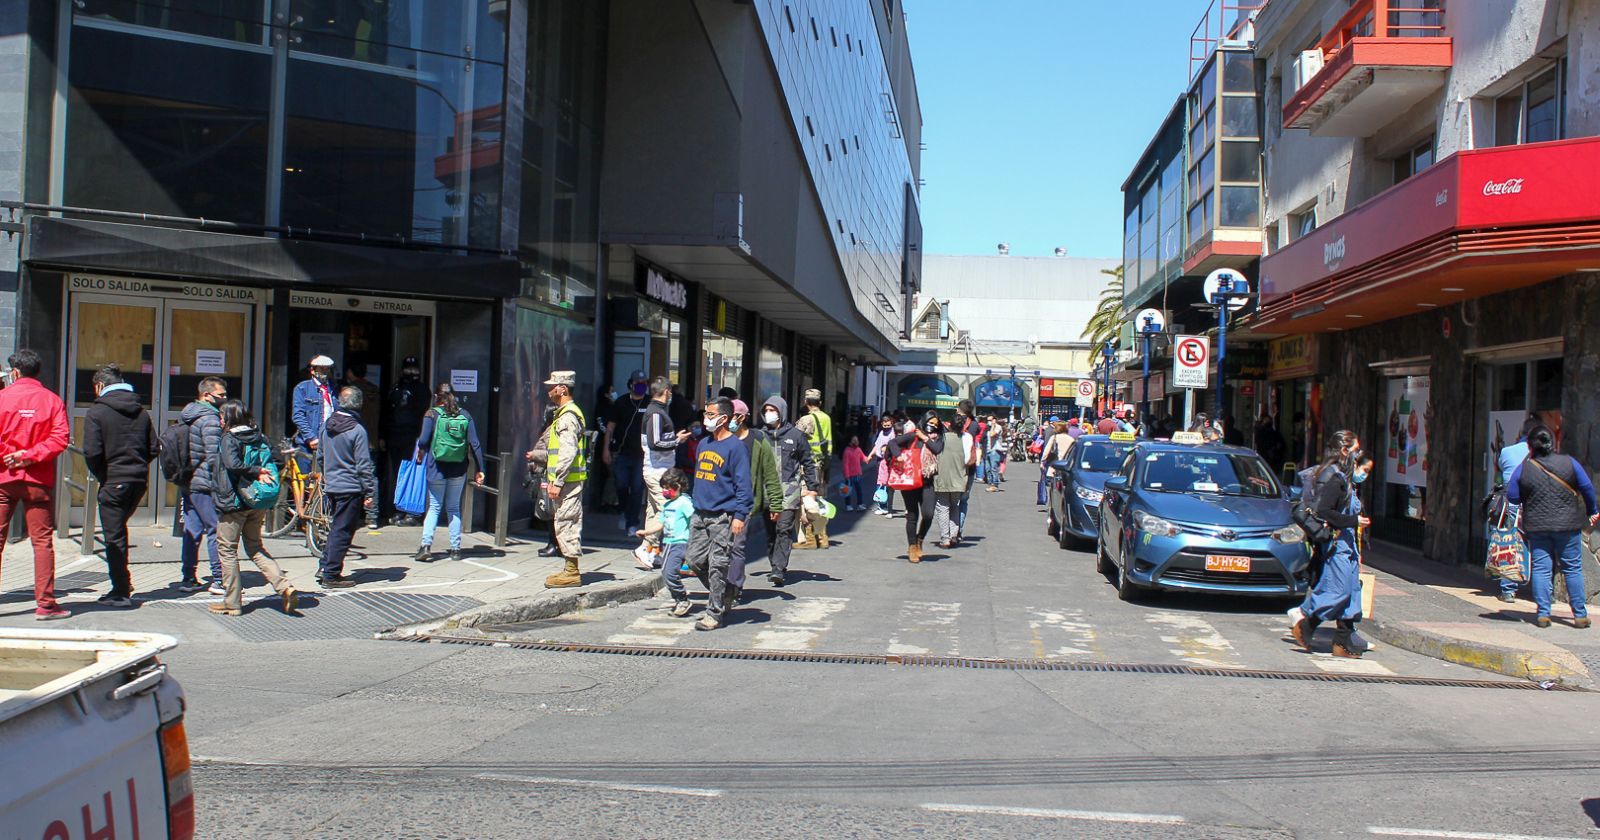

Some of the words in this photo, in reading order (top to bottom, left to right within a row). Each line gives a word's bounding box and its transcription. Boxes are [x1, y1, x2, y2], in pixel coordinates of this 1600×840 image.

[73, 277, 105, 289] SOLO
[108, 280, 150, 293] SALIDA
[183, 286, 213, 297] SOLO
[215, 288, 255, 300] SALIDA
[291, 295, 333, 307] ENTRADA
[373, 301, 413, 312] ENTRADA
